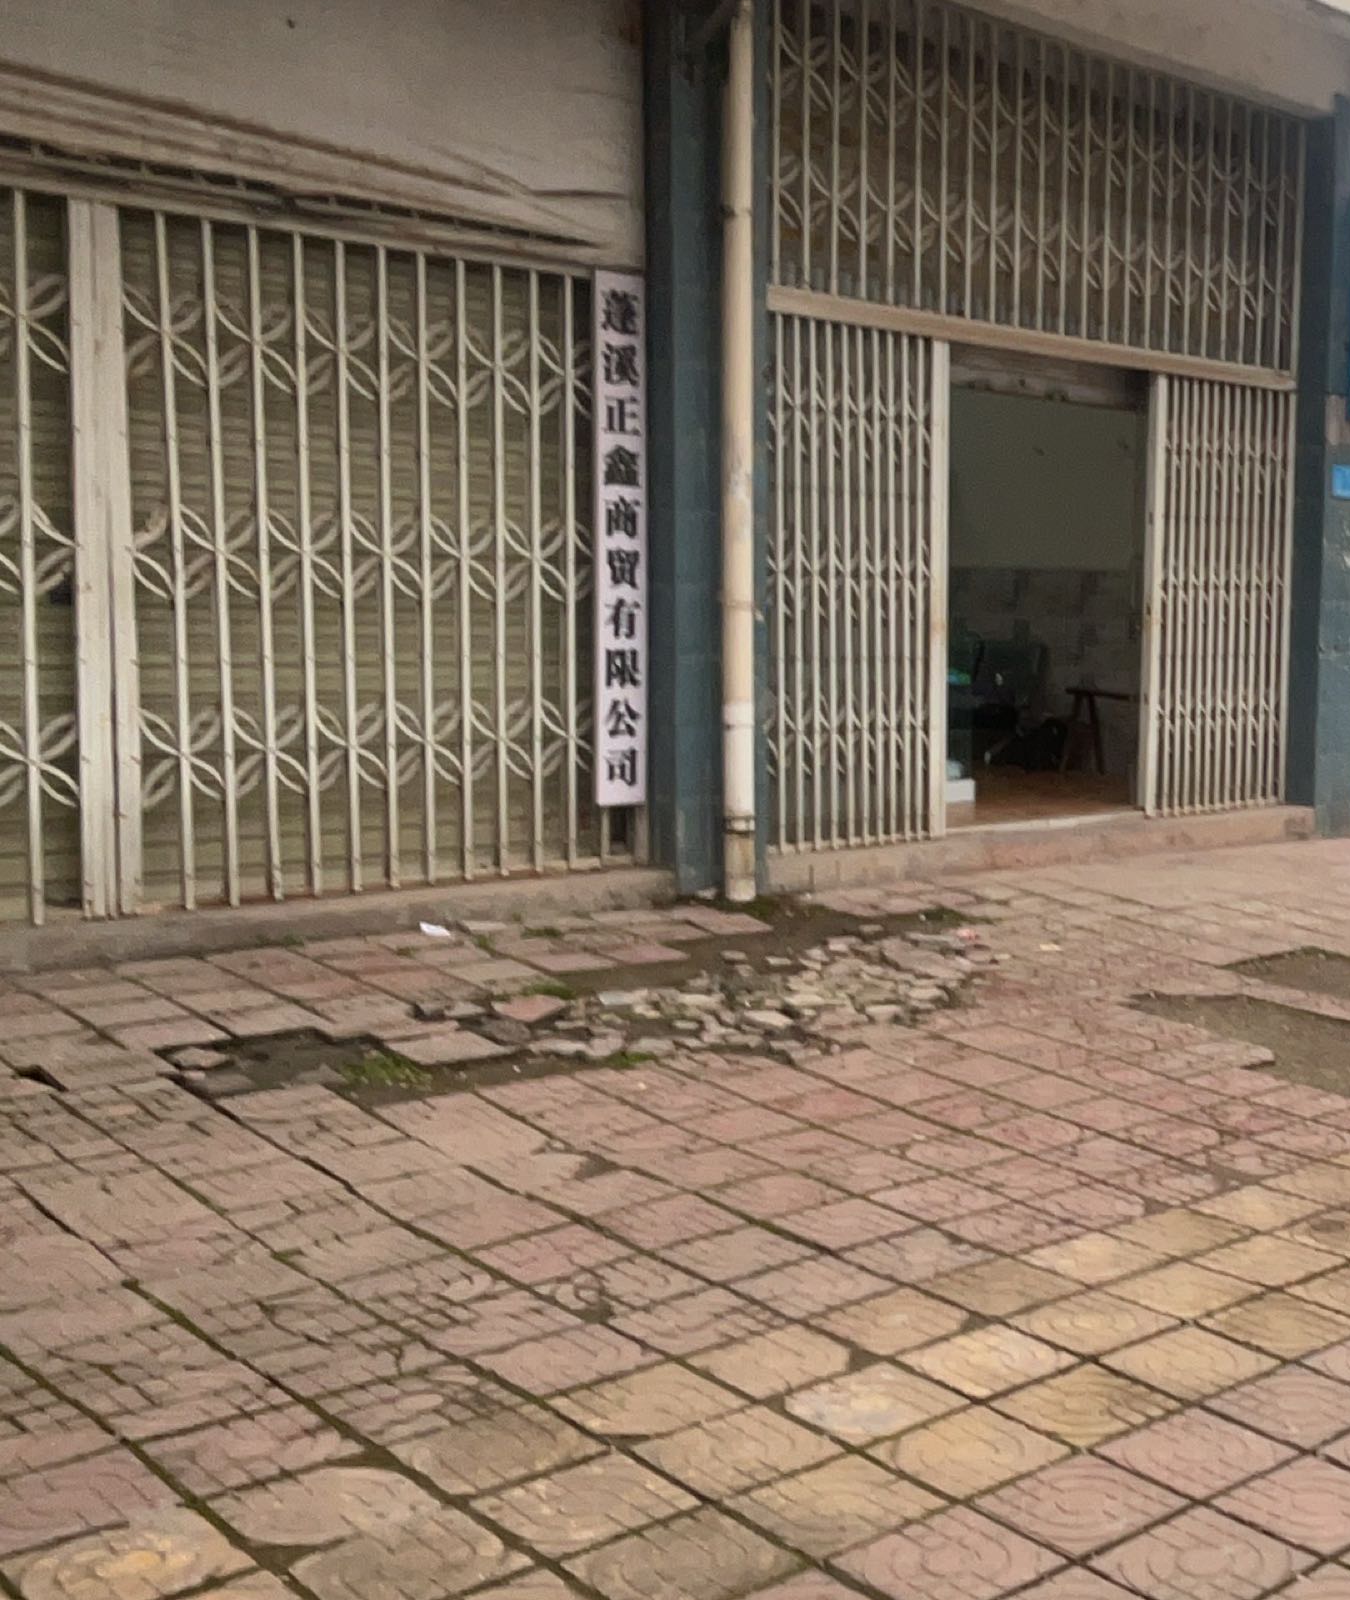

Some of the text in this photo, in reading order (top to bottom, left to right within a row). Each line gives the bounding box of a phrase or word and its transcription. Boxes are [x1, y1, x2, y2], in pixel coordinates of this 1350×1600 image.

[601, 289, 641, 788] 蓬溪正鑫商贸有限公司
